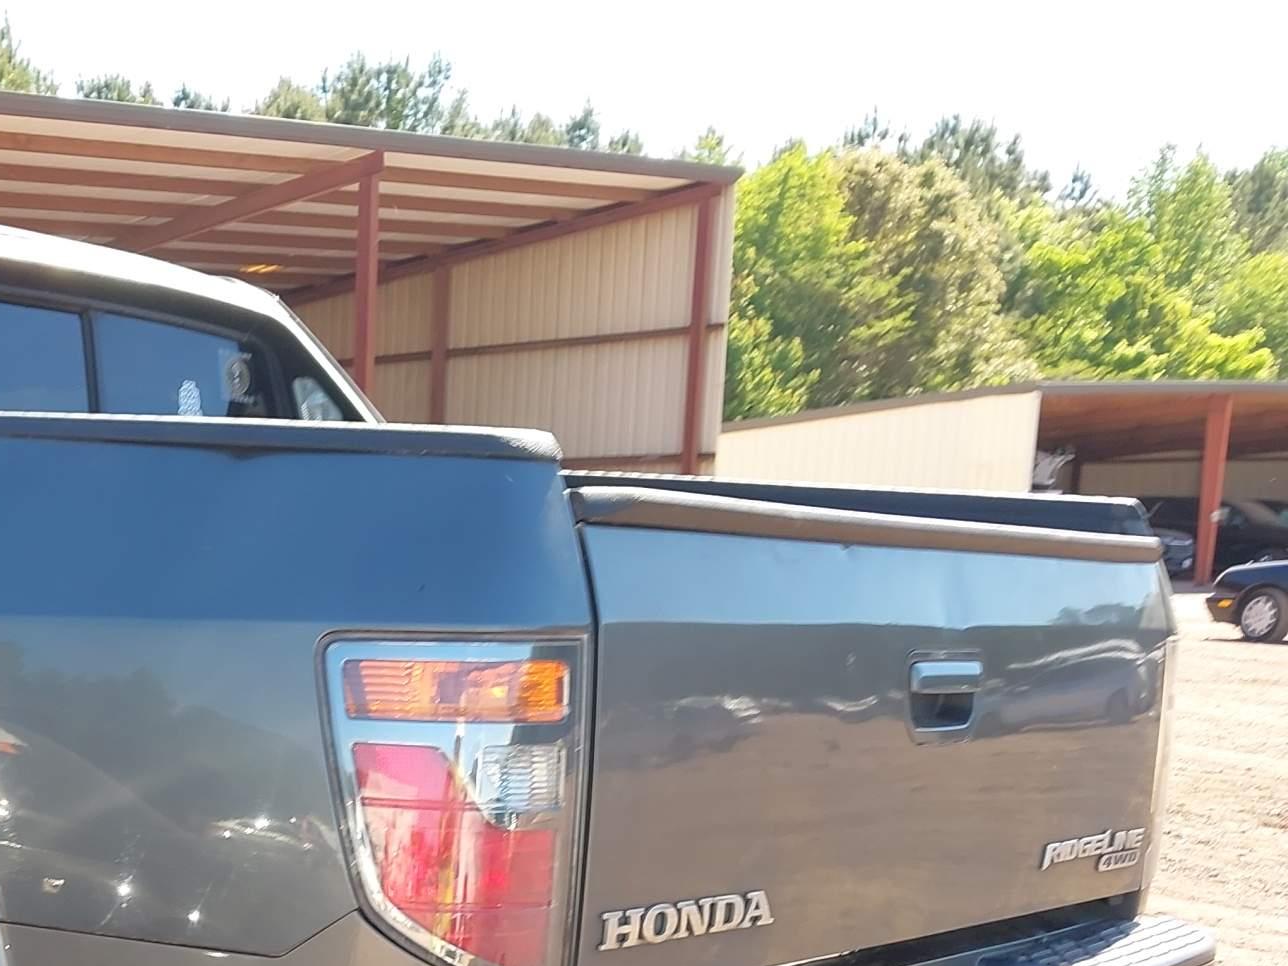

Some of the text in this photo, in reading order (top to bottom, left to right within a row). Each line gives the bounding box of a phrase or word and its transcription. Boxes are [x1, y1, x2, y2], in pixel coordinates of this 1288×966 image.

[1040, 827, 1146, 872] RIDGELINE
[1101, 850, 1139, 869] 4WD
[597, 889, 775, 952] HONDA
